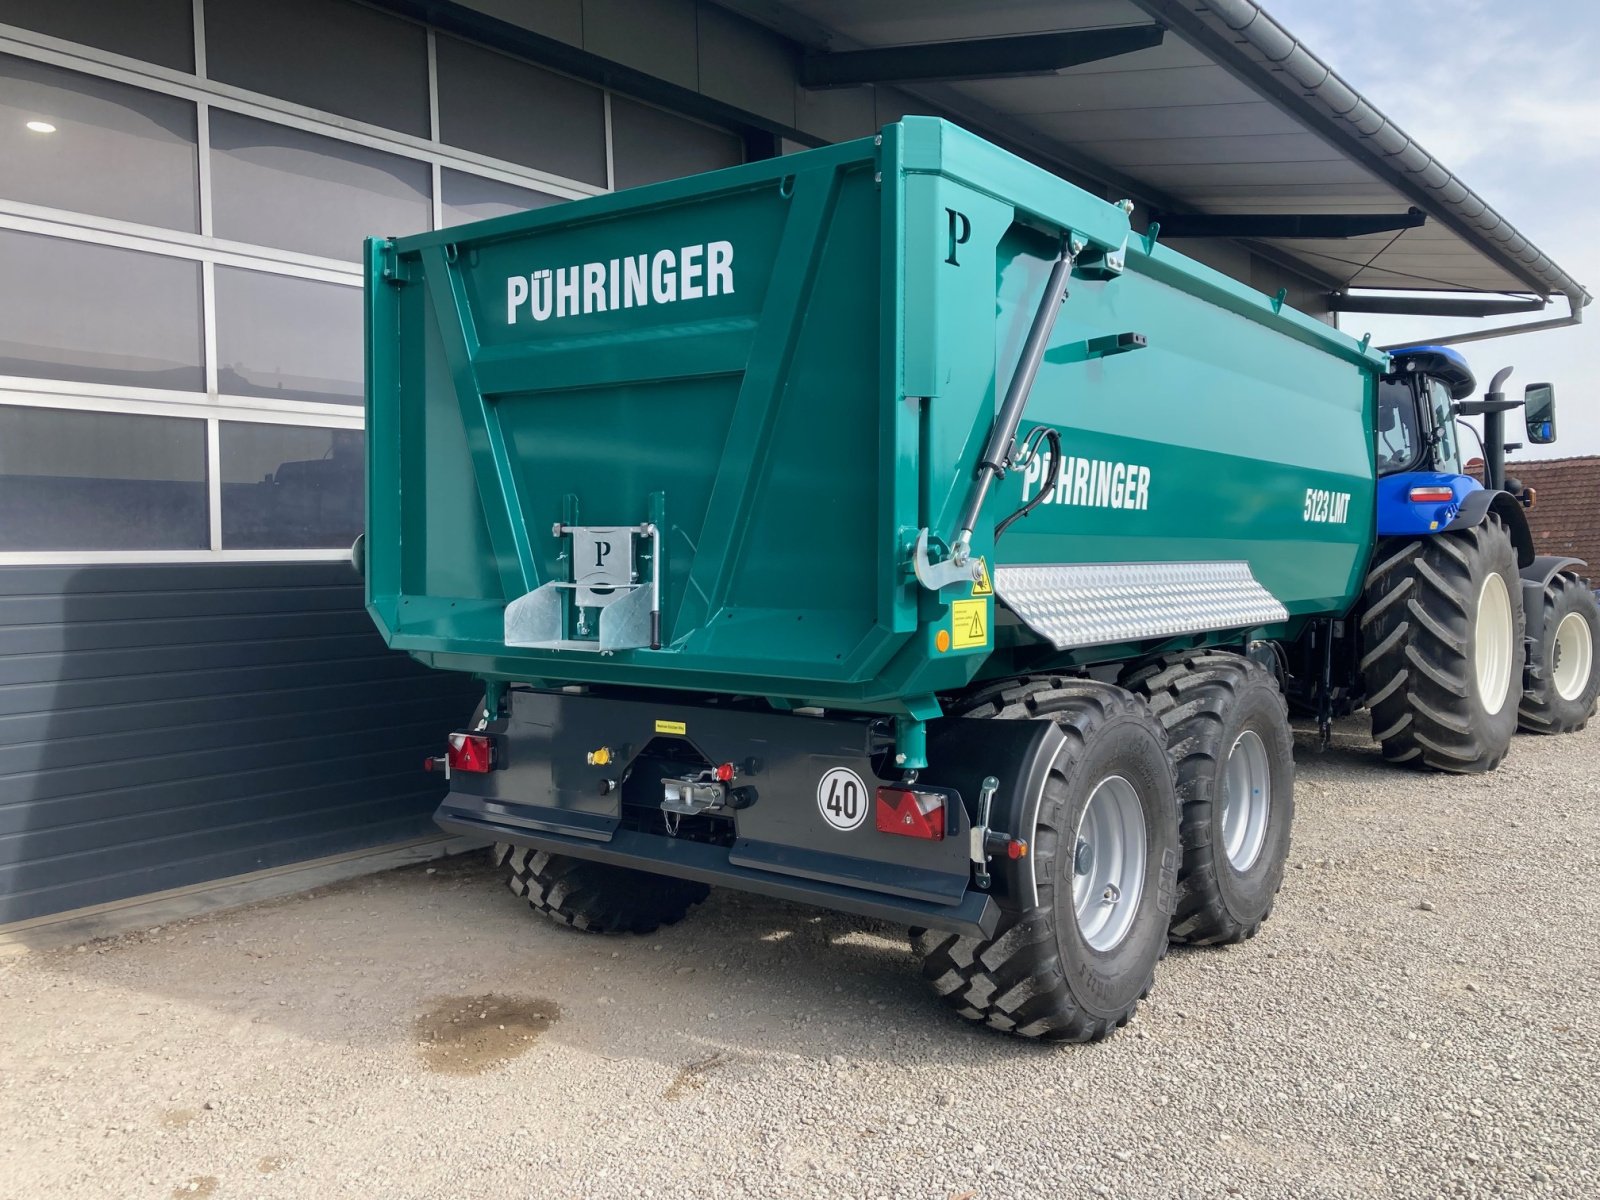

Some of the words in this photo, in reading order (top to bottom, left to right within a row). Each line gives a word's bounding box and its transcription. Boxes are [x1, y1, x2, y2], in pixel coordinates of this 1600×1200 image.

[944, 206, 972, 268] P
[507, 240, 735, 325] PÜHRINGER
[1303, 488, 1330, 523] 5123
[1328, 491, 1351, 524] LMT
[594, 541, 611, 567] P
[826, 778, 858, 820] 40
